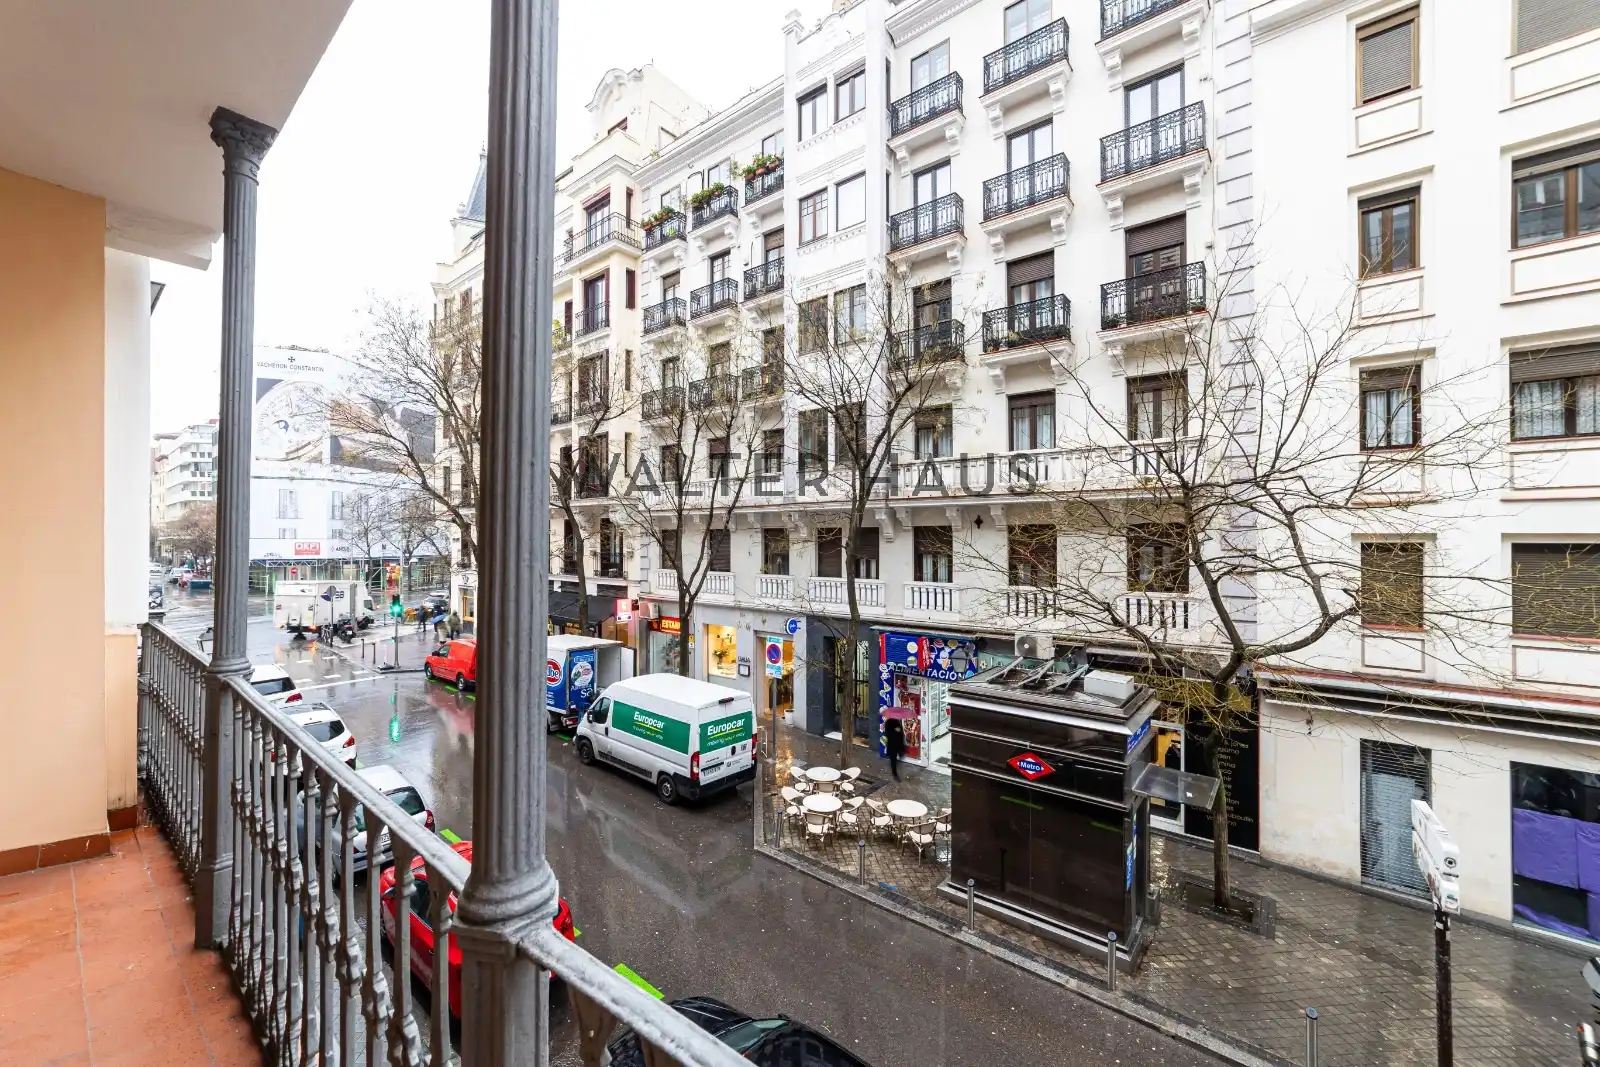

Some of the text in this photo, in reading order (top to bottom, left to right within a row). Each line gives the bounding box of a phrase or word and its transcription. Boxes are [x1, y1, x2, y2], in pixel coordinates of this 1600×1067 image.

[289, 364, 324, 372] CONSTANTIN
[633, 711, 665, 729] Europcar
[707, 718, 745, 736] Europcar
[1020, 761, 1041, 771] Metro
